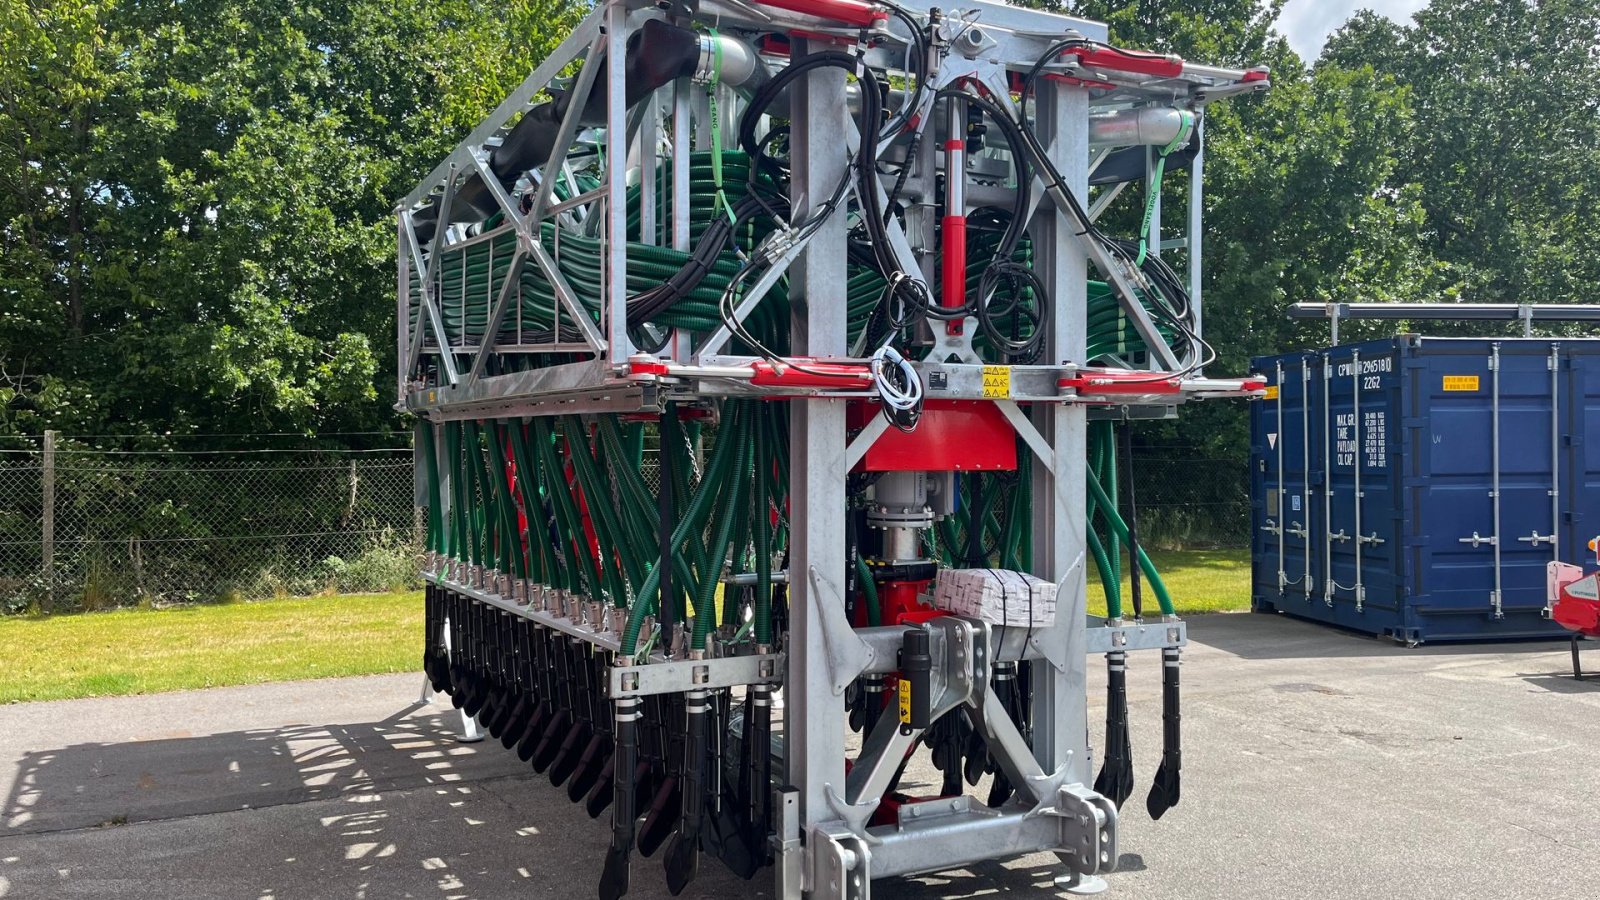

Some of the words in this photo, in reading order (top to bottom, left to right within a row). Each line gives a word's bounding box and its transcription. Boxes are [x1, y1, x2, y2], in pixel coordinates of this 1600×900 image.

[1143, 191, 1157, 229] VOGELSANG
[1364, 376, 1381, 390] 22G2
[1337, 427, 1348, 440] TARE
[1337, 440, 1356, 453] PAYLOAD
